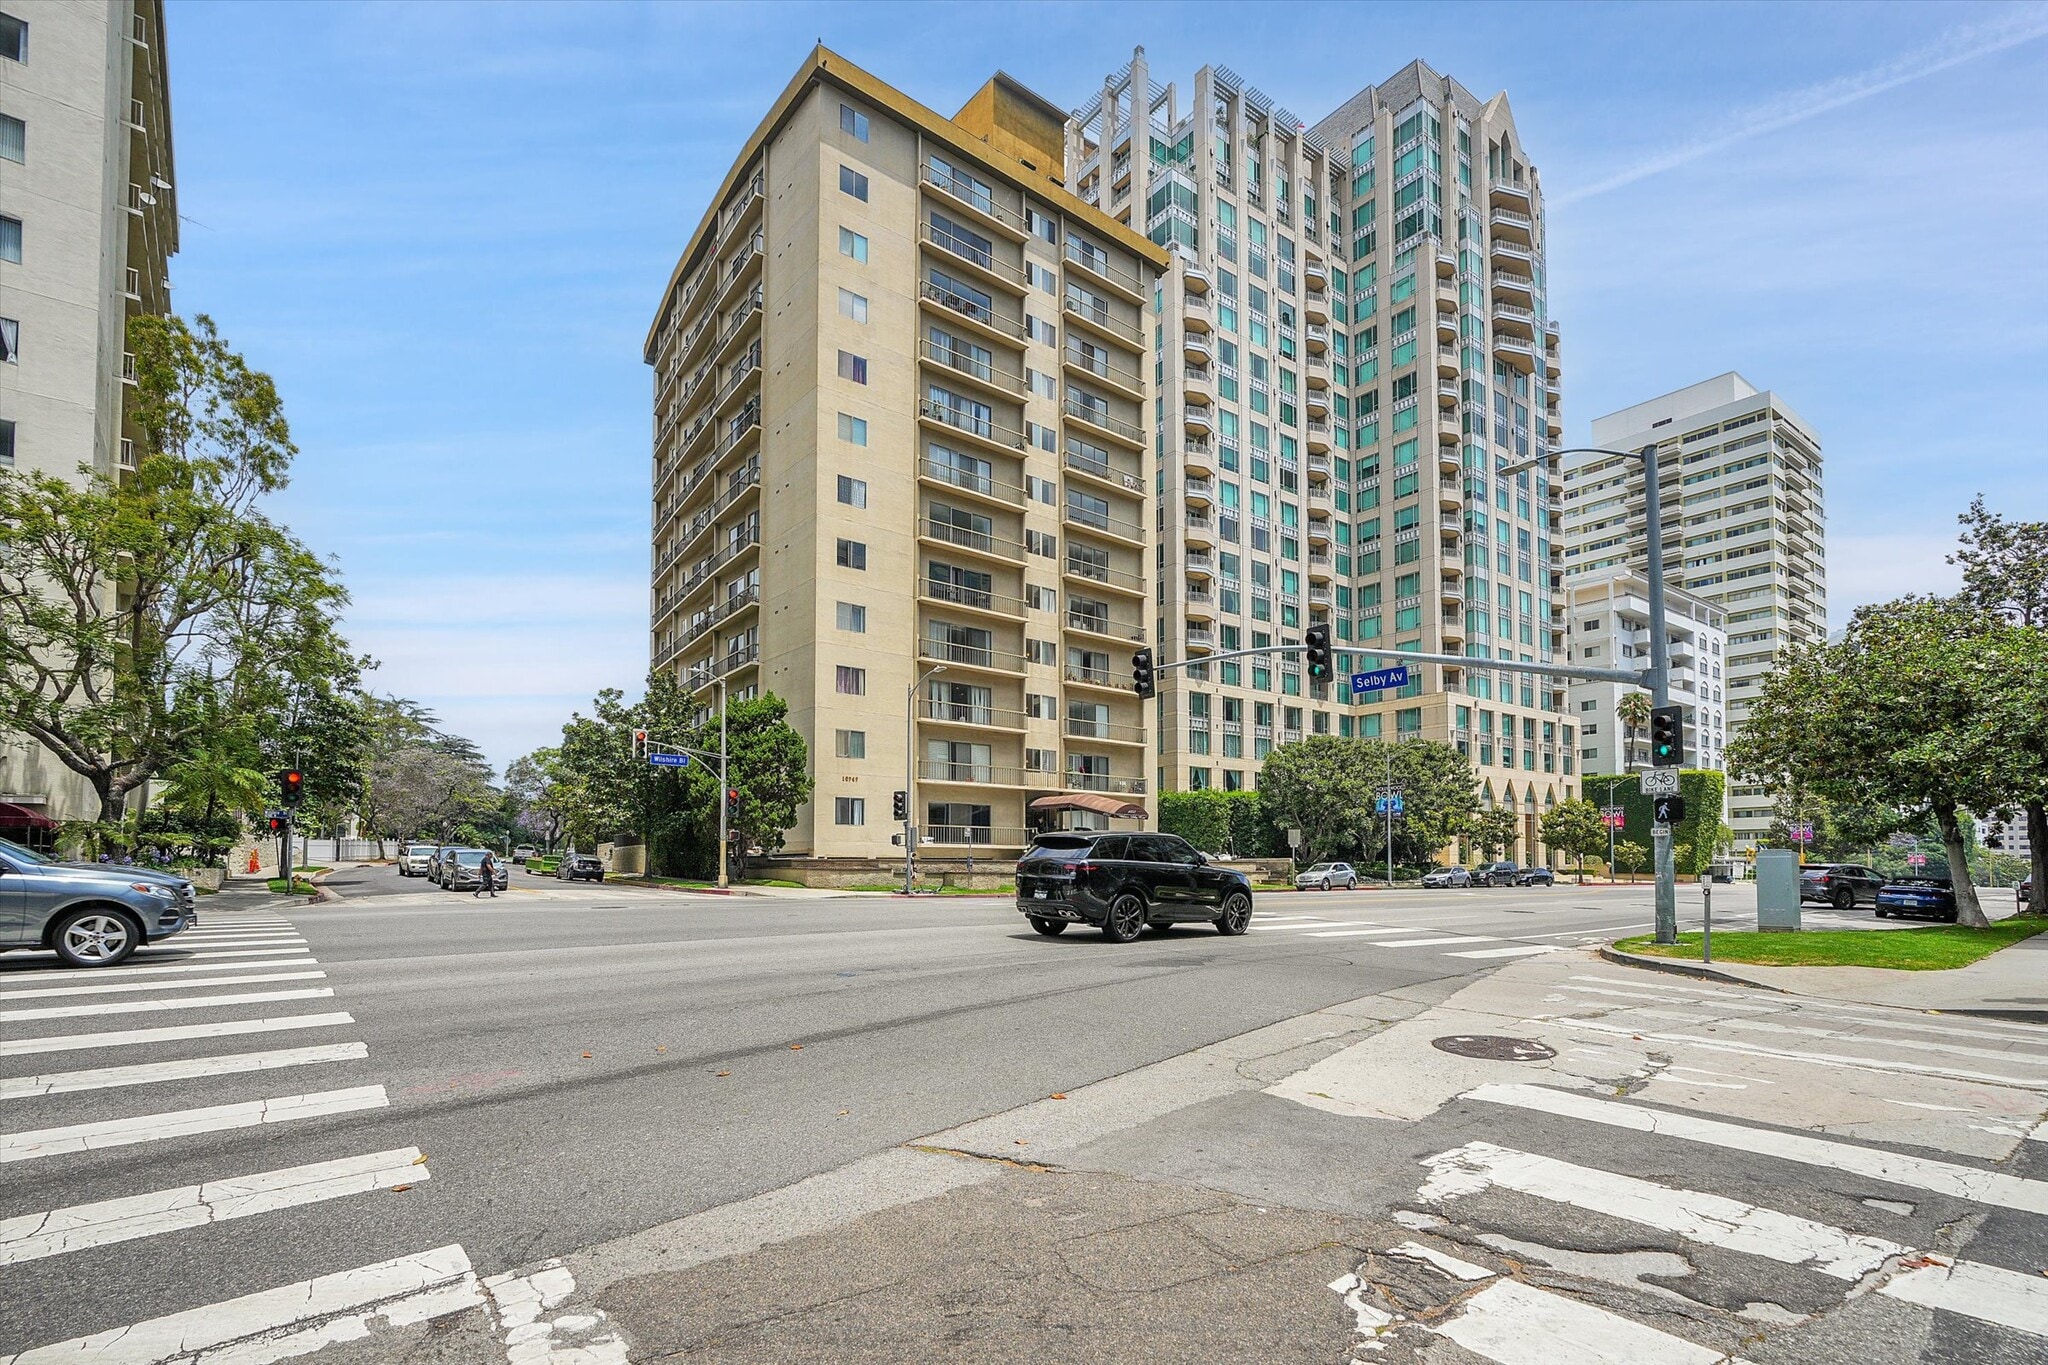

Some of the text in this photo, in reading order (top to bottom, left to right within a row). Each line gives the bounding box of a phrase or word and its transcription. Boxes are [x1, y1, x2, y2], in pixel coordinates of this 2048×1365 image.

[1356, 672, 1403, 688] Selby Av
[653, 755, 678, 764] Wilshire
[1660, 785, 1675, 793] LANE
[1375, 791, 1402, 800] BOWL
